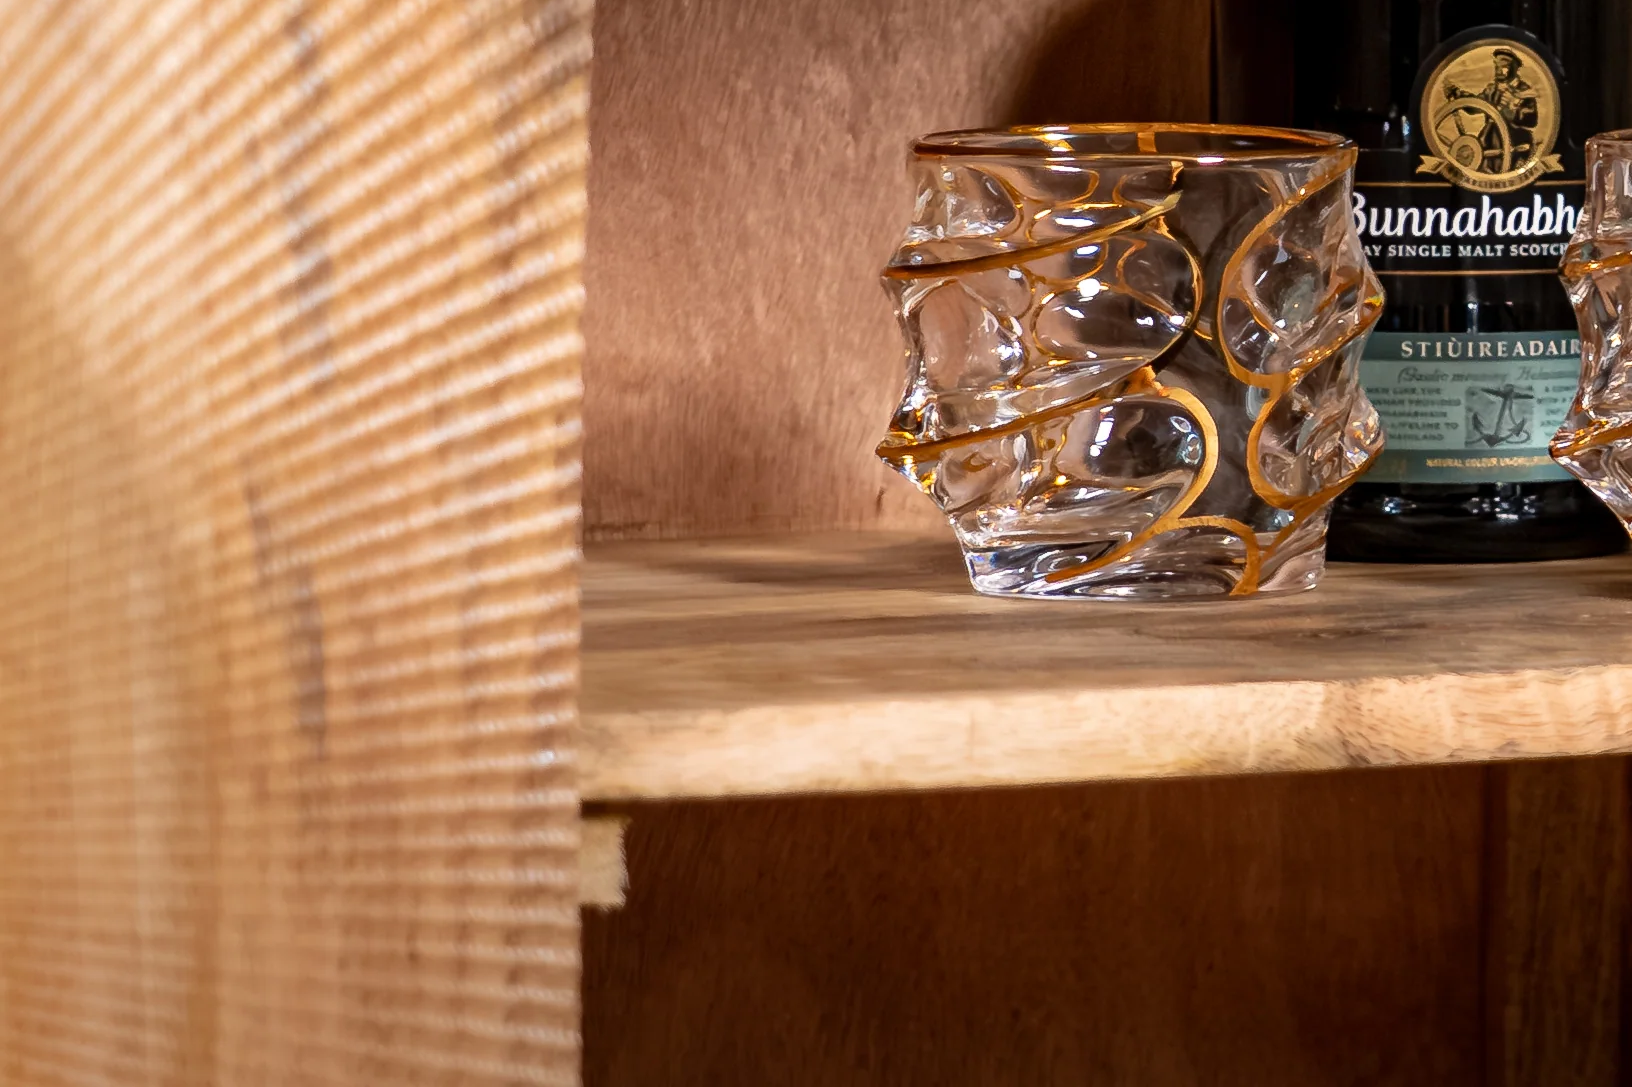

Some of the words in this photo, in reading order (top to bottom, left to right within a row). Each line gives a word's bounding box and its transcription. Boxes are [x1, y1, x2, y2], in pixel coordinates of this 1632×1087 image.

[1352, 192, 1585, 237] Bunnahabh
[1387, 244, 1452, 257] SINGLE
[1457, 244, 1505, 257] MALT
[1400, 336, 1581, 359] STIÙIREADAIR
